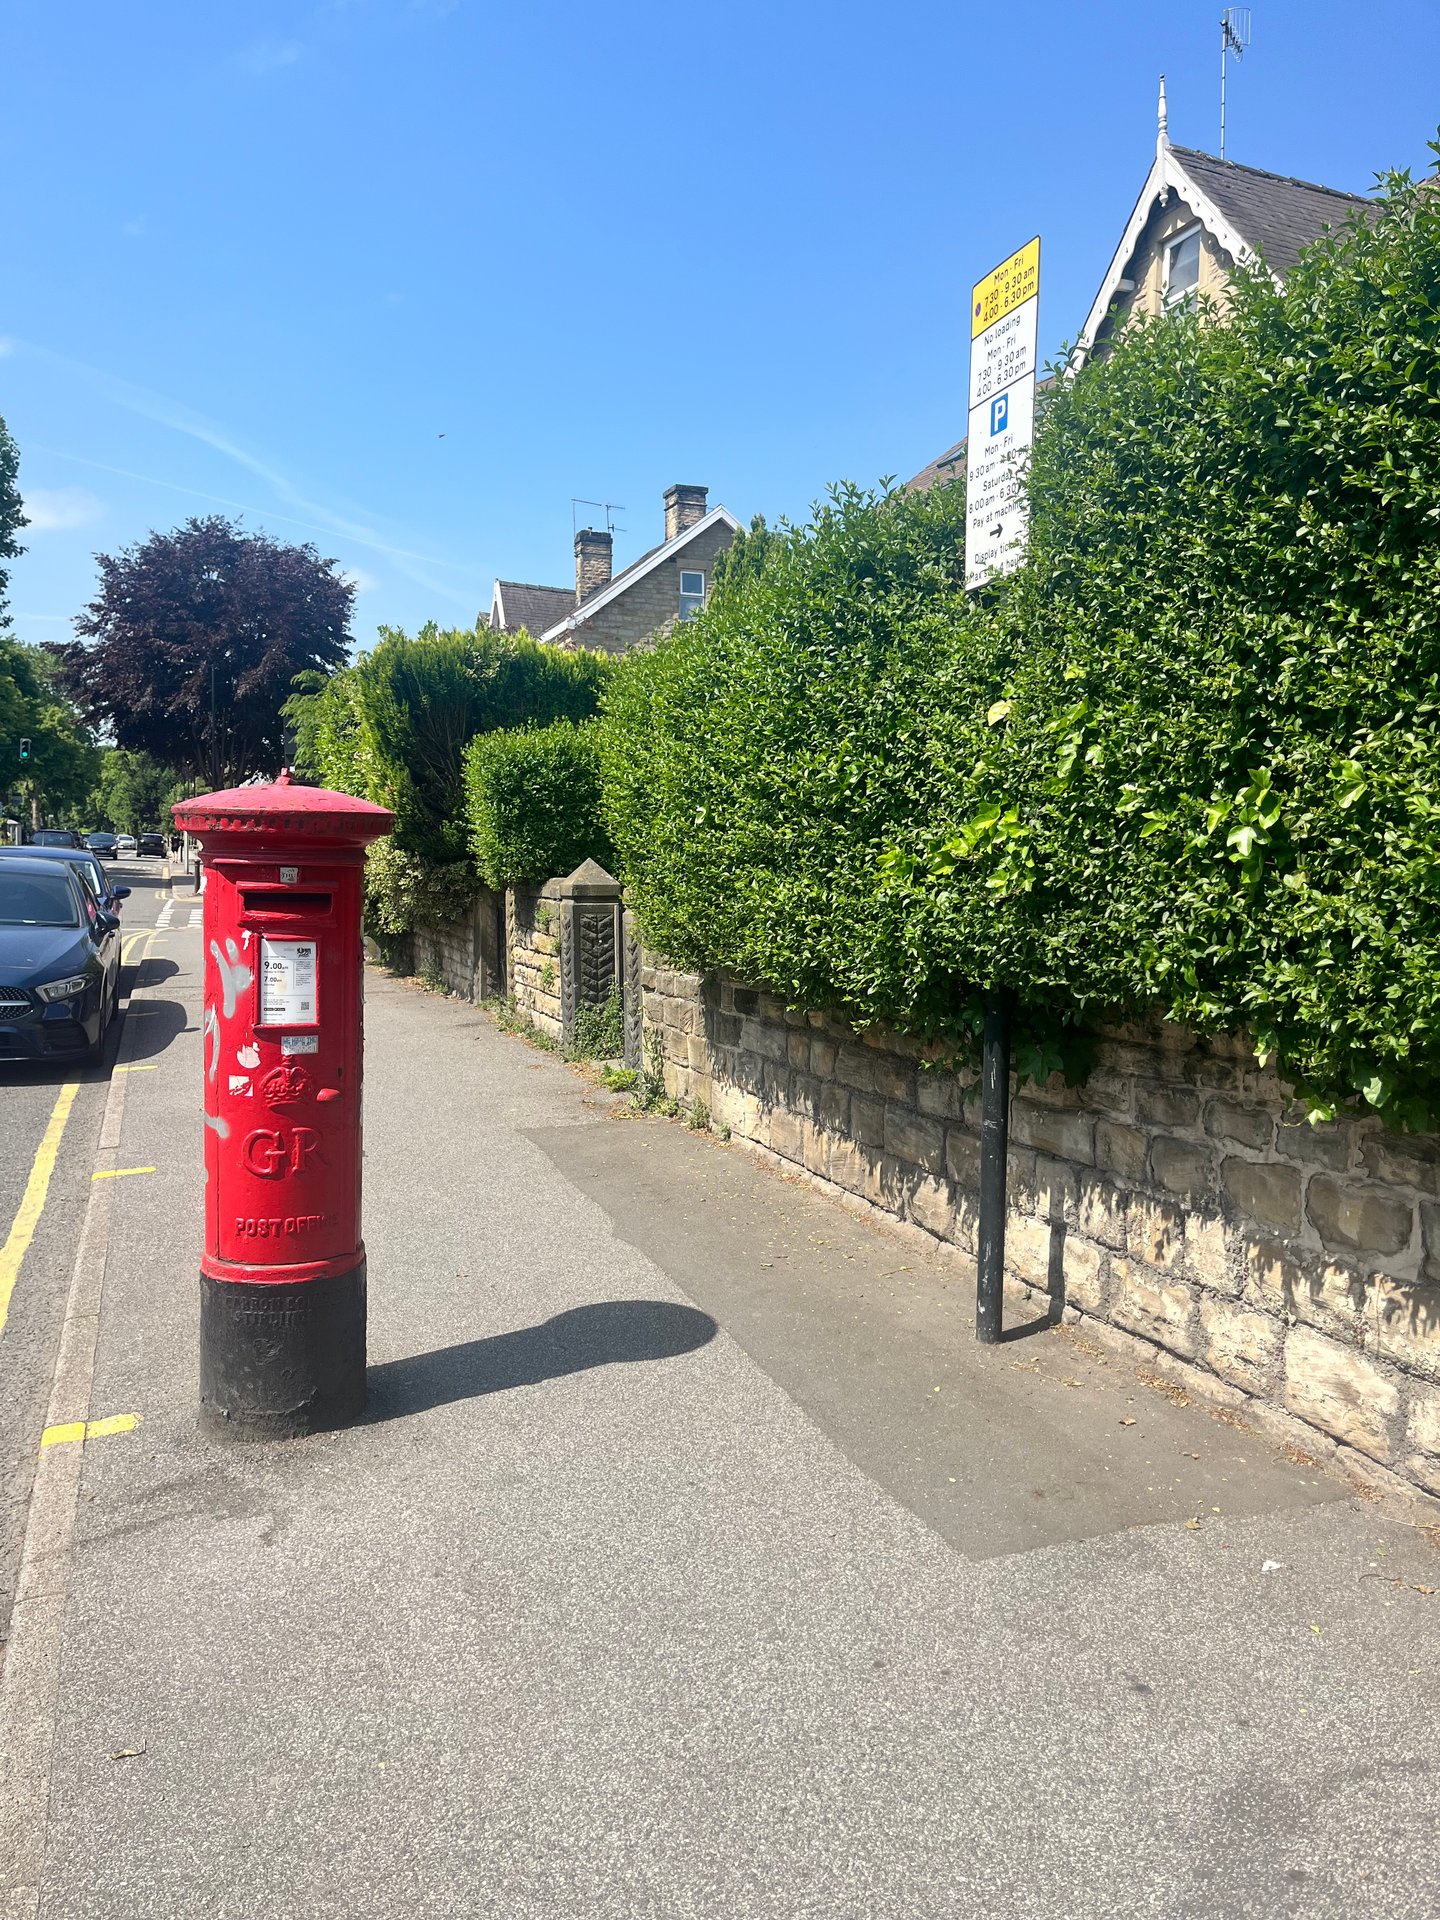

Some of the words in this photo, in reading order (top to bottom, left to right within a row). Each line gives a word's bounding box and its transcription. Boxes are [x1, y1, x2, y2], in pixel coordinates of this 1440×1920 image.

[994, 269, 1008, 285] Mon
[1014, 254, 1024, 270] Fri
[1005, 272, 1022, 293] 9.30
[1024, 266, 1034, 280] am
[1004, 287, 1021, 308] 6.30
[1022, 281, 1034, 297] pm
[984, 334, 993, 346] No
[995, 314, 1020, 338] loading
[987, 346, 1002, 362] Mon
[1006, 333, 1016, 348] Fri
[998, 350, 1014, 370] 9.30
[1016, 346, 1026, 359] am
[997, 366, 1014, 384] 6.30
[1015, 360, 1026, 376] pm
[994, 398, 1006, 432] P
[984, 444, 998, 458] Mon
[1004, 433, 1013, 447] Fri
[970, 464, 984, 482] 9.30
[986, 462, 996, 473] am
[968, 498, 984, 514] 8.00
[985, 495, 995, 506] am
[1000, 482, 1016, 498] 6.30
[972, 517, 984, 528] Pay
[986, 512, 992, 522] at
[974, 548, 998, 564] Display
[235, 1217, 282, 1238] POST
